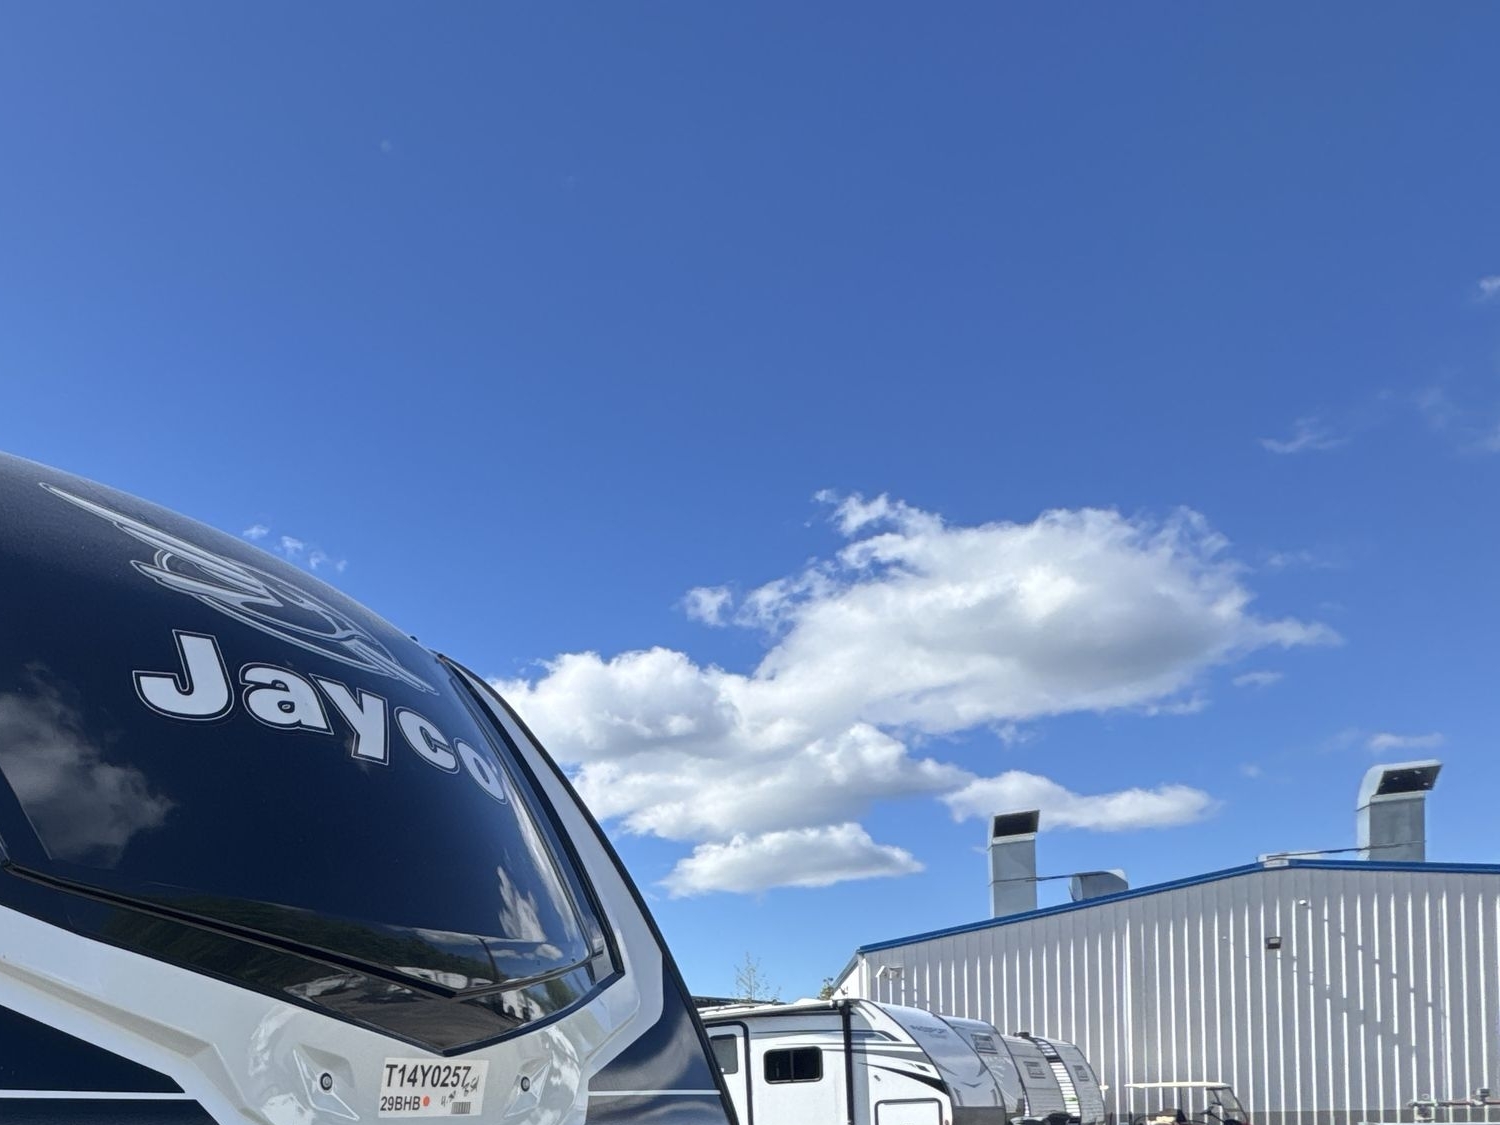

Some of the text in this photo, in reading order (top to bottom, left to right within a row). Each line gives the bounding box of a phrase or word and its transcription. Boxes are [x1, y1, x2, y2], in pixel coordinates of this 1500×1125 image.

[132, 628, 508, 804] Jayco
[386, 1063, 472, 1088] T14Y0257
[380, 1095, 420, 1111] 29BHB
